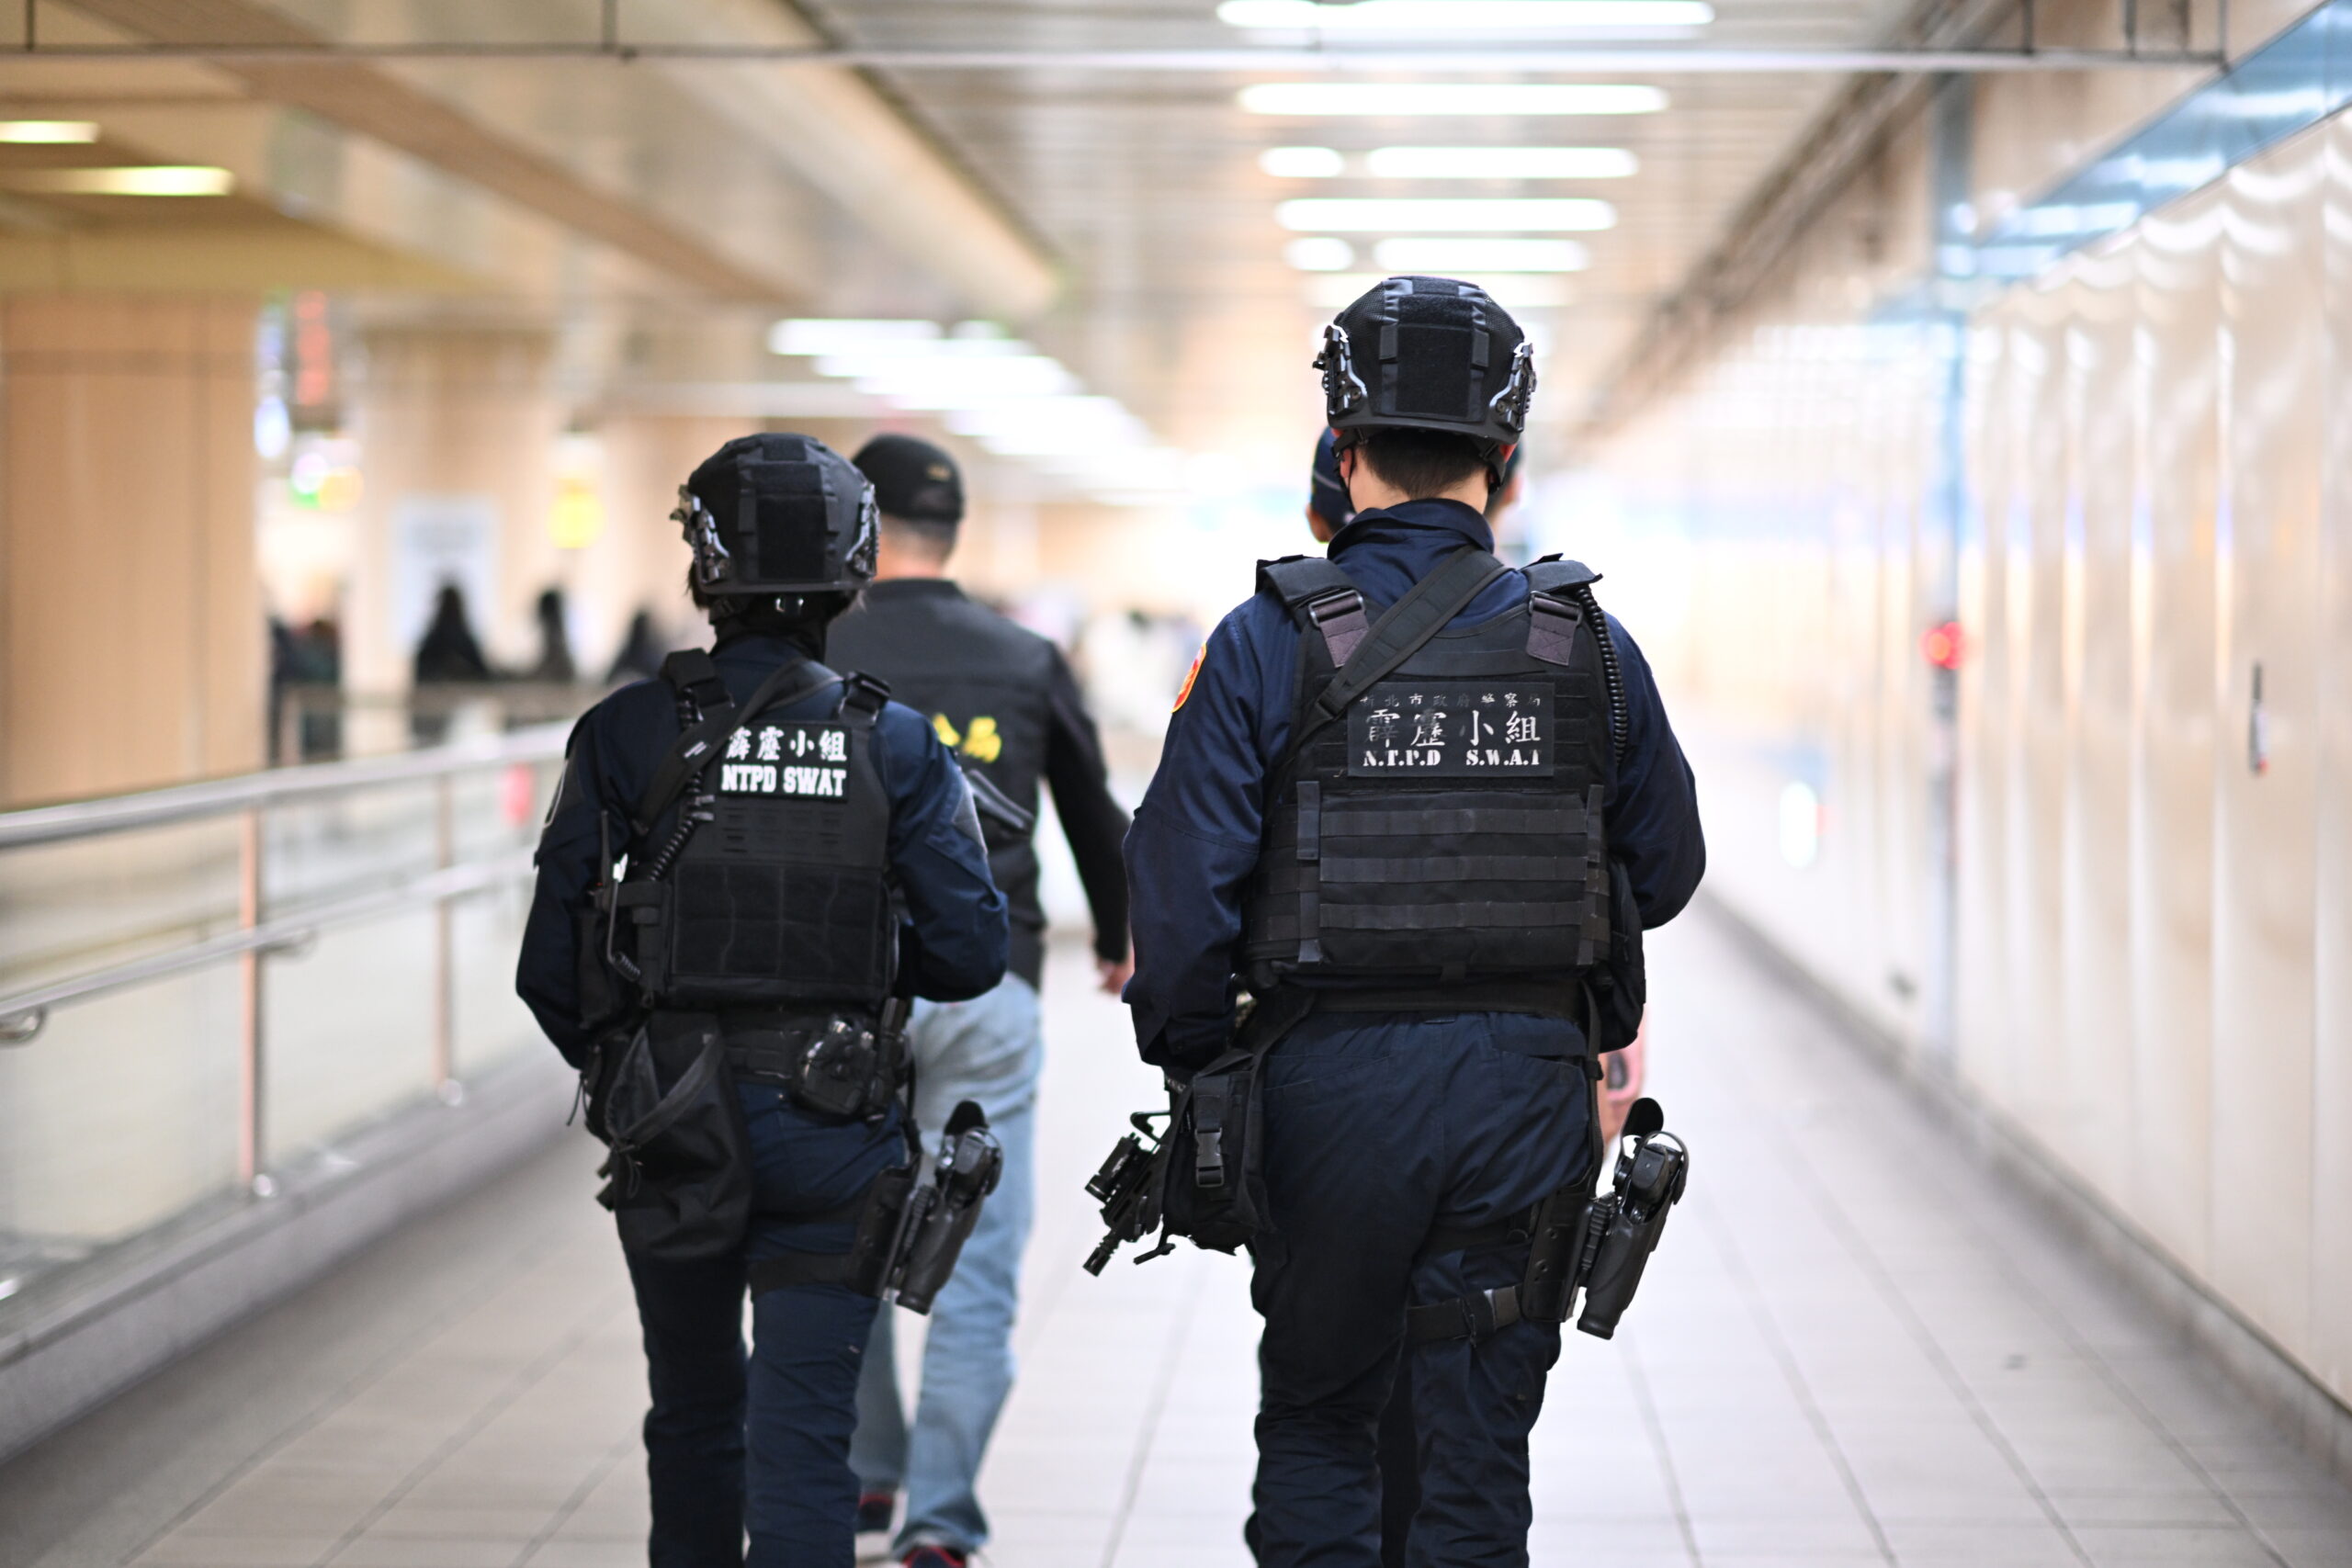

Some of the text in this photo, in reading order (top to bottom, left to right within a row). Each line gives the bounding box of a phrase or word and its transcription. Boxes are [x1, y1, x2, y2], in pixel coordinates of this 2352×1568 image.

[1366, 708, 1541, 748] 霹靂小組
[721, 764, 847, 796] NTPD SWAT
